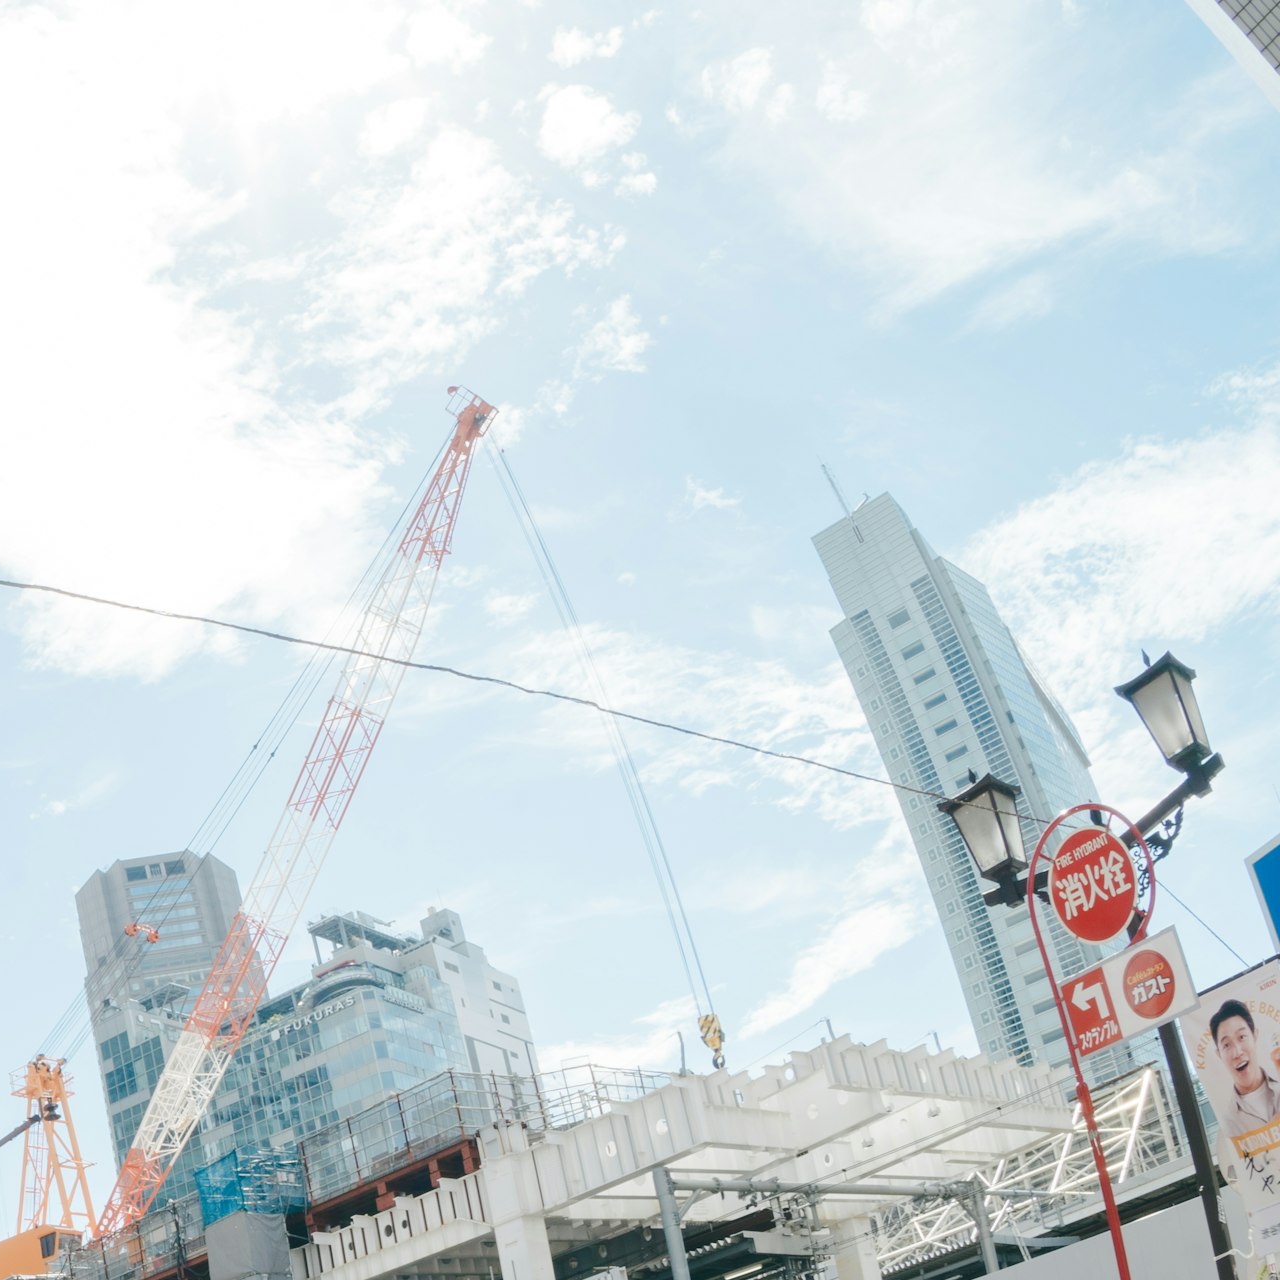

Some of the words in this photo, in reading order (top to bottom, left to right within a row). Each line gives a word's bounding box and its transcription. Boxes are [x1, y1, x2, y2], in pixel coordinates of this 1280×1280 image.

[1055, 852, 1073, 871] FIRE
[1073, 832, 1108, 861] HYDRANT
[1056, 850, 1131, 920] 消火栓
[1131, 975, 1171, 1006] ガスト
[1259, 979, 1278, 992] KIRIN
[283, 996, 355, 1036] FUKURAS
[1079, 1021, 1118, 1051] スクランブル
